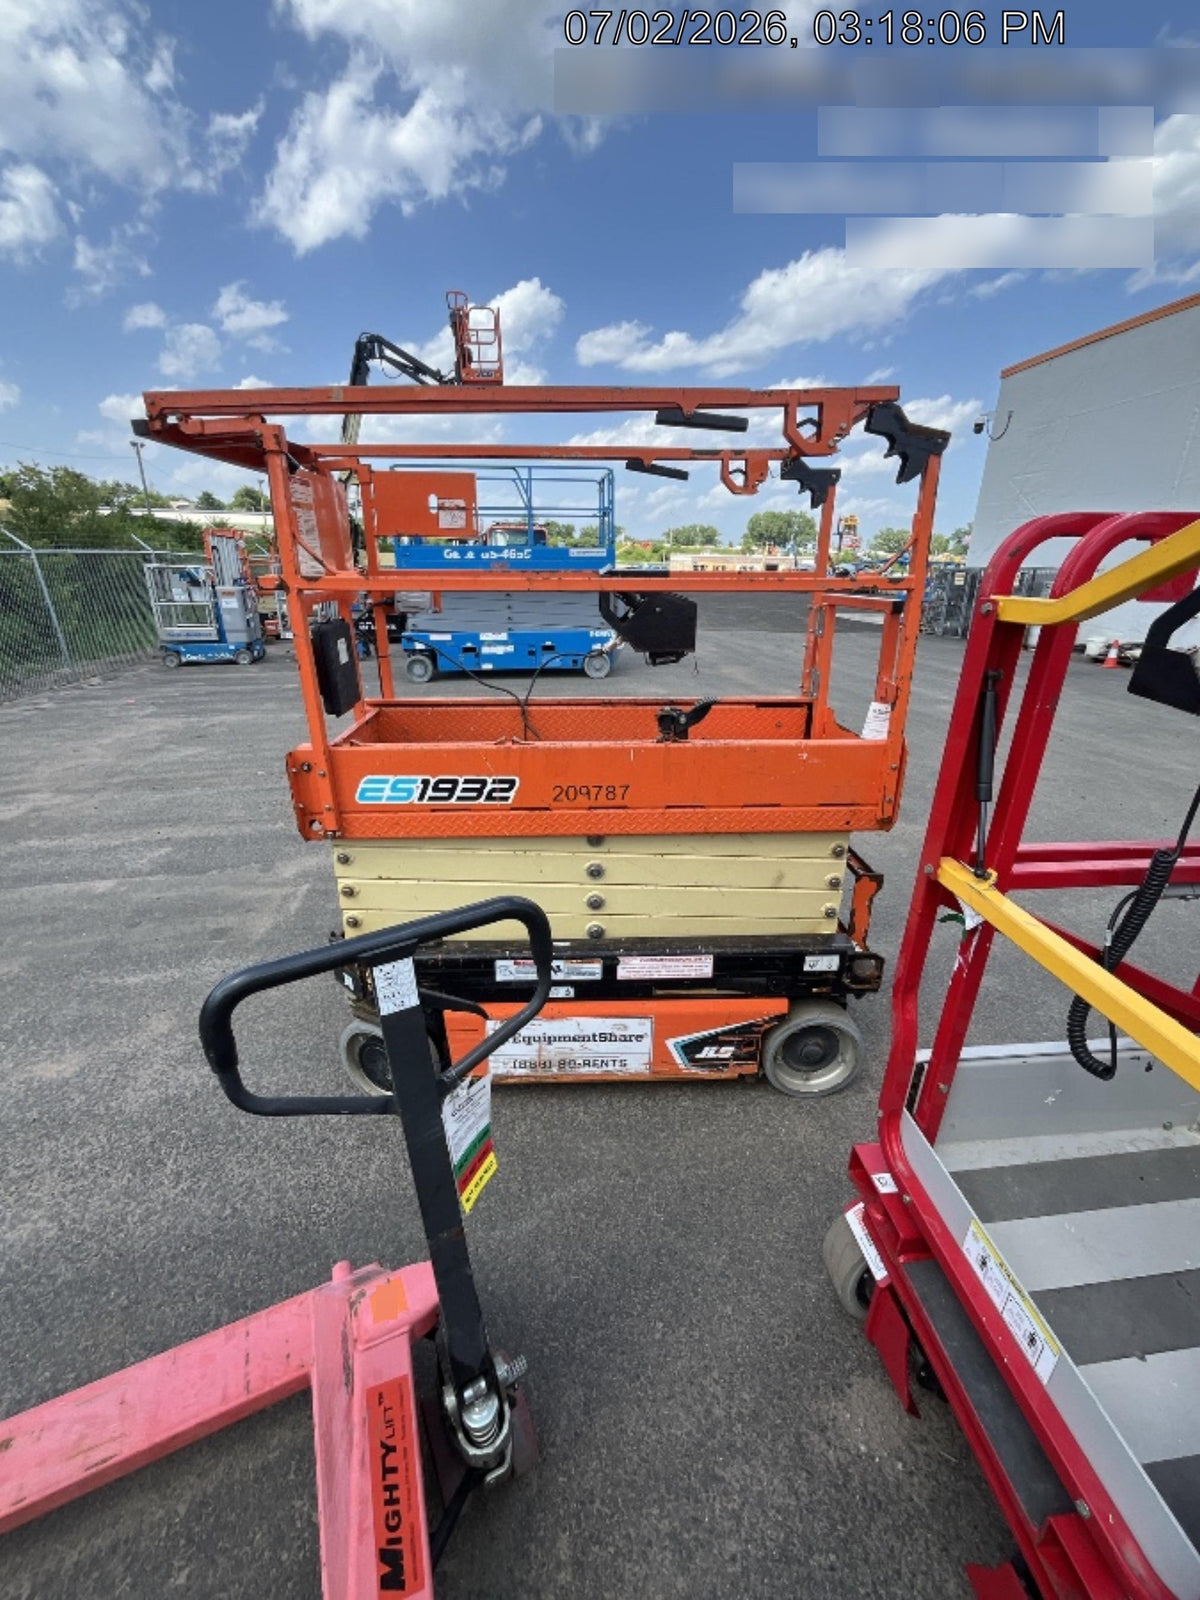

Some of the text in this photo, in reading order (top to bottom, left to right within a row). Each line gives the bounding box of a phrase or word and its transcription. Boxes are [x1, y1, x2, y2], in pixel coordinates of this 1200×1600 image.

[356, 777, 517, 802] ES1932
[552, 784, 630, 803] 209787
[512, 1032, 645, 1046] EquipmentShare
